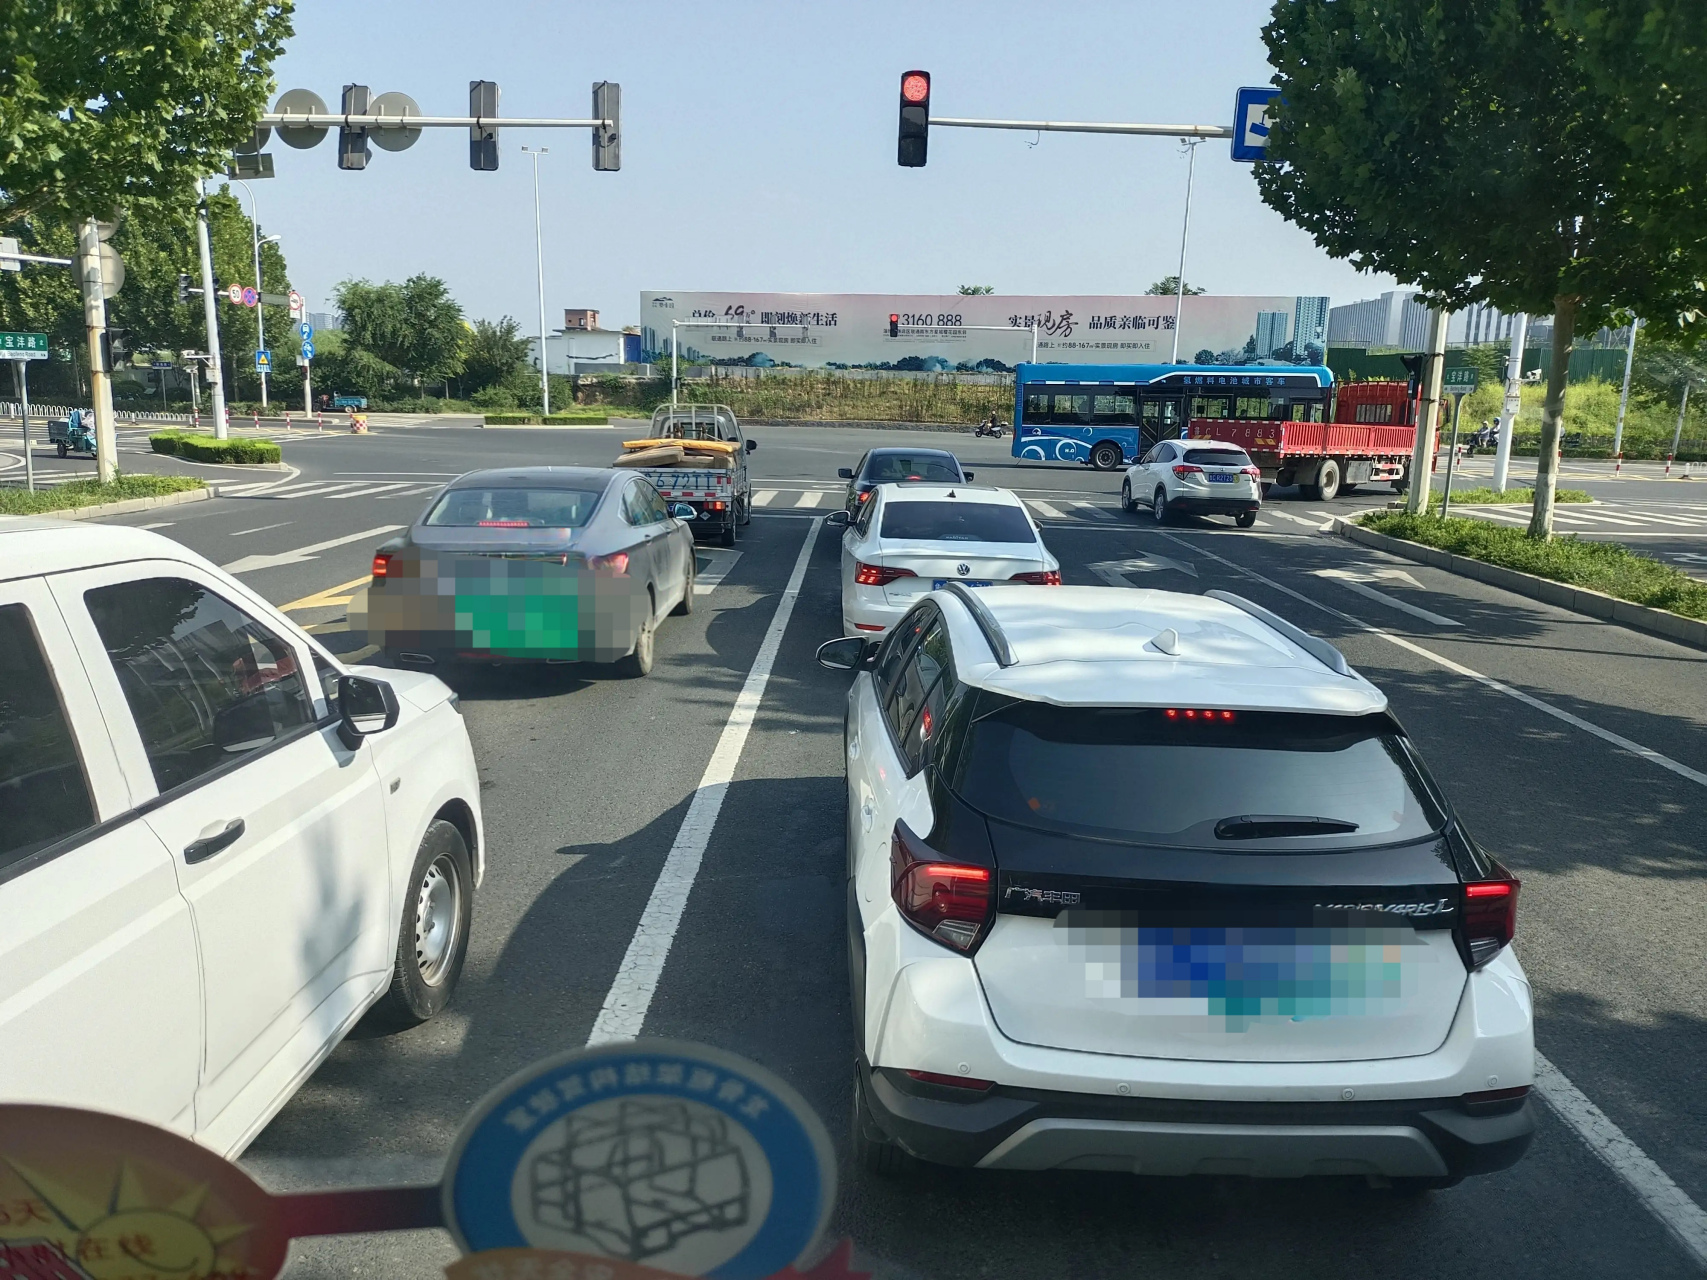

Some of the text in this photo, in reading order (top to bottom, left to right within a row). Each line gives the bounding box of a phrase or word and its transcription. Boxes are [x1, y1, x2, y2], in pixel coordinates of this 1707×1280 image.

[231, 289, 240, 299] 50
[902, 313, 962, 327] 3160 888
[1089, 315, 1176, 330] 品质亲临可鉴
[1183, 376, 1286, 386] 氢燃料电池城市客车
[1004, 886, 1081, 905] 广汽丰田
